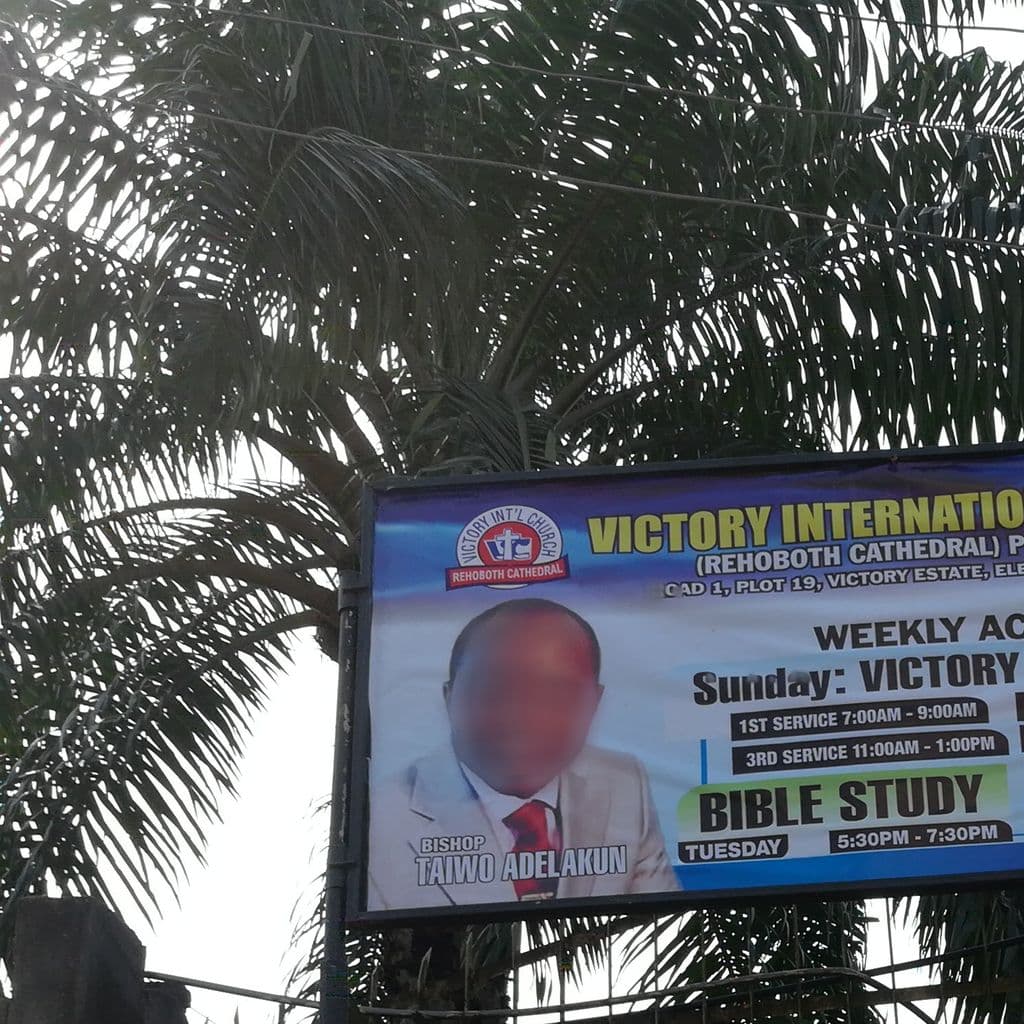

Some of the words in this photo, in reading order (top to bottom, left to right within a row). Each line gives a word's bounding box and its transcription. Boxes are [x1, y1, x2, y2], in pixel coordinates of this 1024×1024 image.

[461, 516, 490, 563] VICTORY
[491, 508, 524, 523] INT'L
[527, 512, 557, 558] CHURCH
[587, 506, 771, 554] VICTORY
[452, 568, 505, 583] REHOBOTH
[506, 564, 564, 579] CATHEDRAL
[697, 547, 840, 576] (REHOBOTH
[849, 535, 999, 565] CATHEDRAL)
[712, 581, 731, 598] 1,
[736, 578, 786, 594] PLOT
[793, 576, 823, 593] 19,
[827, 569, 910, 588] VICTORY
[914, 564, 990, 582] ESTATE,
[814, 616, 966, 651] WEEKLY
[693, 667, 846, 706] Sunday:
[859, 652, 1019, 692] VICTORY
[740, 717, 767, 734] 1ST
[773, 713, 838, 732] SERVICE
[842, 707, 901, 727] 7:00AM
[918, 702, 977, 720] 9:00AM
[745, 751, 778, 767] 3RD
[783, 746, 848, 764] SERVICE
[852, 740, 919, 758] 11:00AM
[935, 735, 995, 752] 1:00PM
[700, 784, 824, 833] BIBLE
[838, 774, 984, 822] STUDY
[420, 835, 486, 854] BISHOP
[685, 838, 783, 861] TUESDAY
[836, 830, 909, 849] 5:30PM
[927, 824, 999, 842] 7:30PM
[415, 853, 496, 886] TAIWO
[501, 845, 627, 882] ADELAKUN
